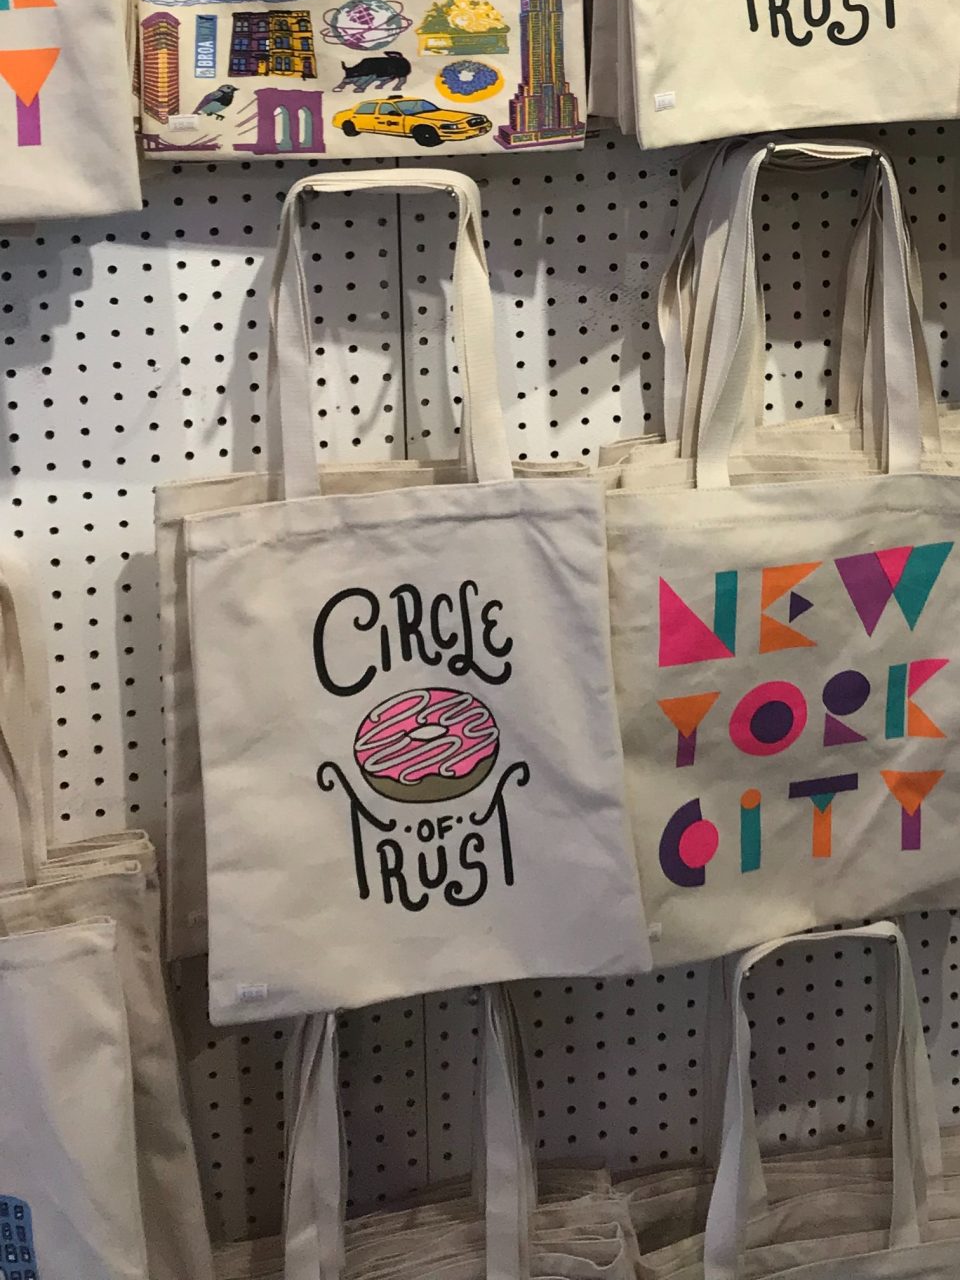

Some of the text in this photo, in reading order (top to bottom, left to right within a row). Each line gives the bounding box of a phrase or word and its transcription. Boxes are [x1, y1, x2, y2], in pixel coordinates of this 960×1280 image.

[658, 541, 955, 667] NEW
[657, 659, 950, 768] YORK
[317, 761, 530, 911] TRUST
[417, 815, 454, 842] OF
[659, 770, 946, 887] CITY
